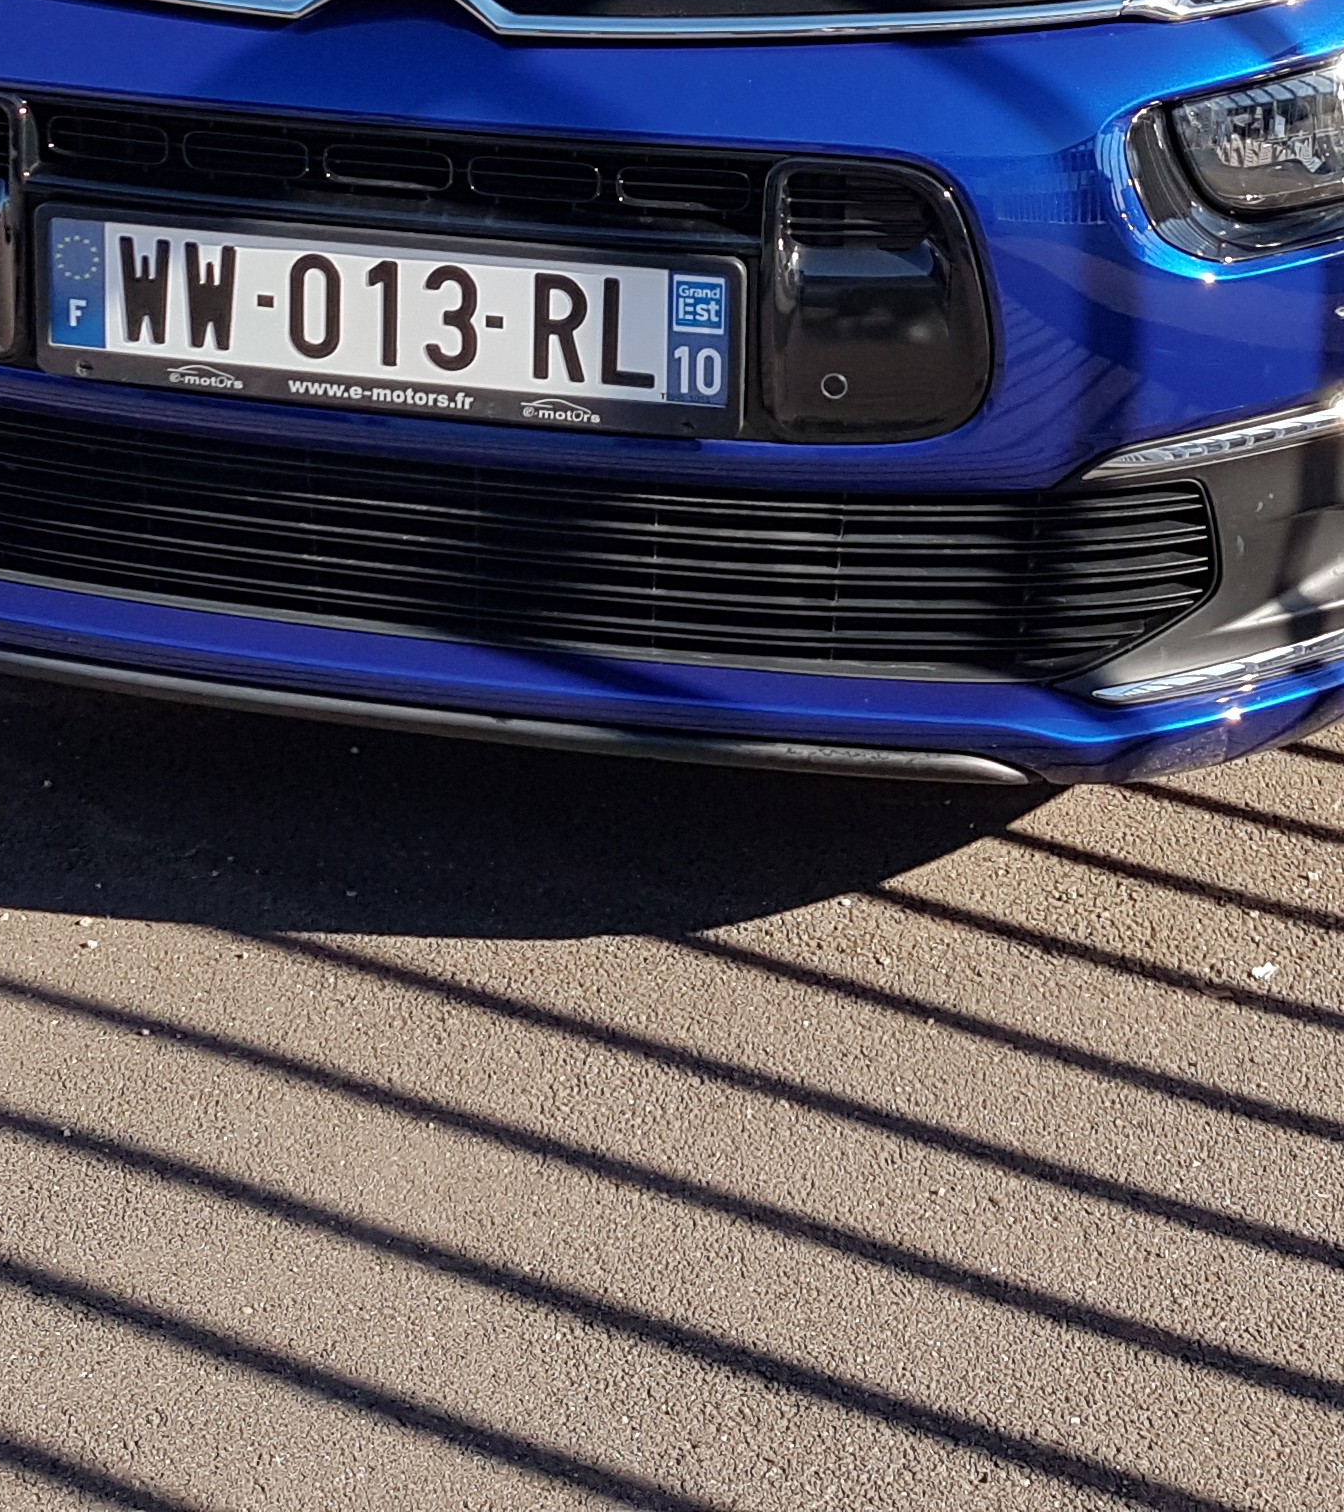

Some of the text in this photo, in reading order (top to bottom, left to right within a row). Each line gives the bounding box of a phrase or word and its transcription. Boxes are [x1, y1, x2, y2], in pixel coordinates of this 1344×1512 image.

[678, 285, 721, 299] Grand
[68, 298, 87, 327] F
[118, 235, 656, 389] WW-013-RL
[678, 297, 720, 322] Est
[674, 345, 722, 396] 10
[287, 377, 474, 410] www.e-motors.fr
